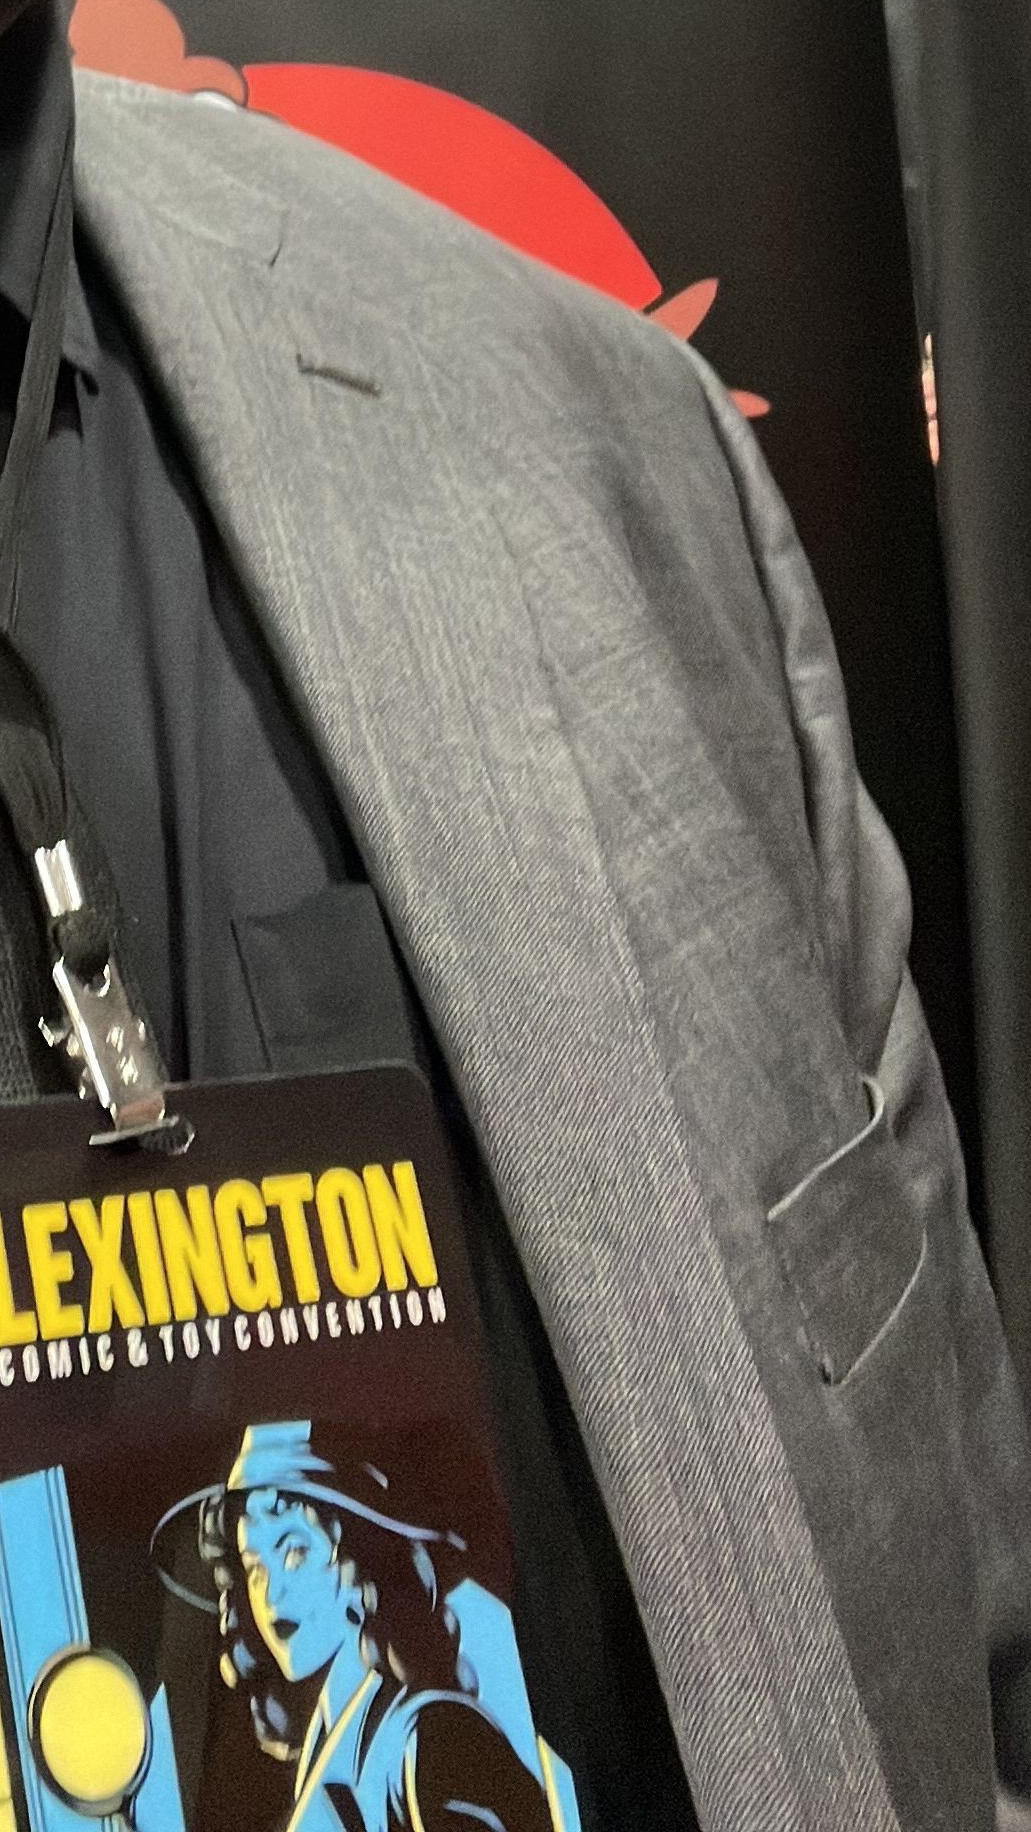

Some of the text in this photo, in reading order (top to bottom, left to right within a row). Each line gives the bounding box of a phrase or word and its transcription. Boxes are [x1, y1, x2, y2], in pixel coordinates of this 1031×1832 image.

[127, 1328, 149, 1367] &
[159, 1318, 220, 1362] TOY
[234, 1287, 446, 1351] CONVENTION
